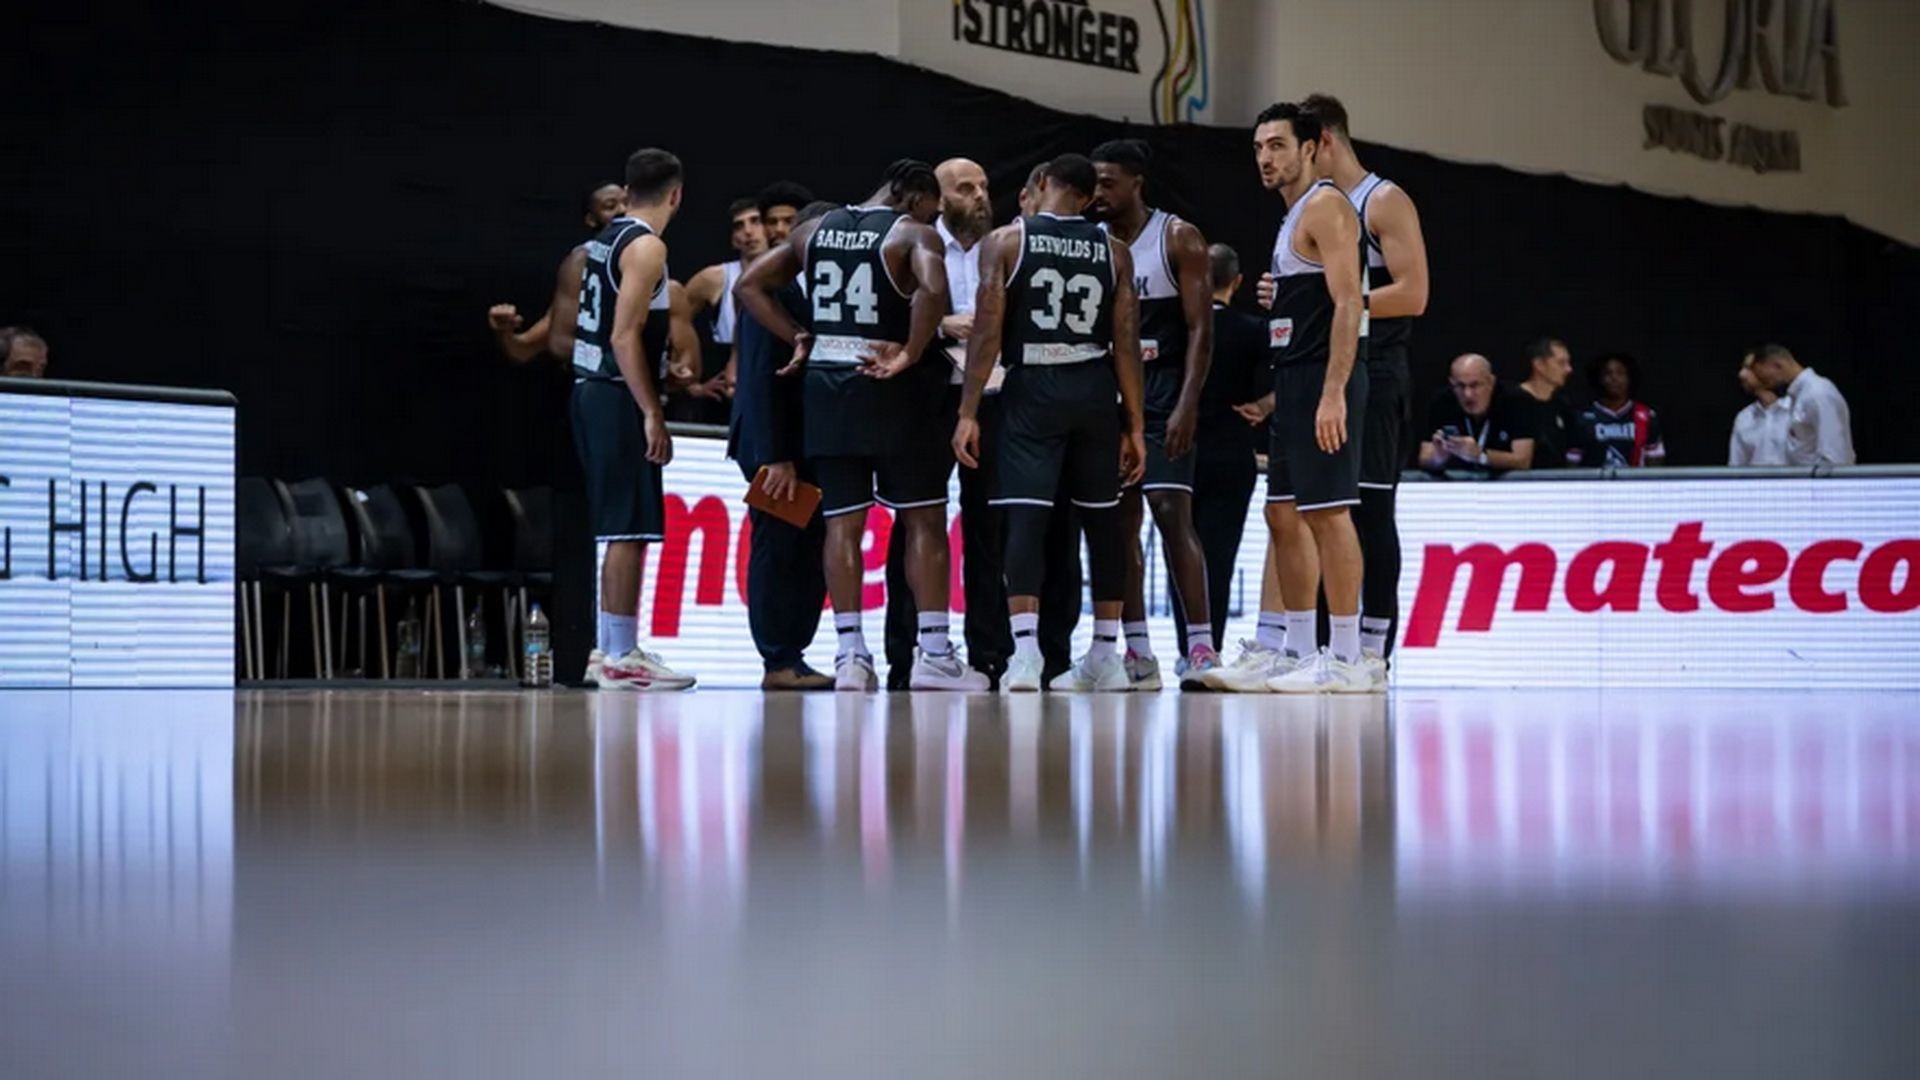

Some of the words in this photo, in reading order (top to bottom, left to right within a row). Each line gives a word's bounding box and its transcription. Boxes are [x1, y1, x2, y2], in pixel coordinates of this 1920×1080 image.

[816, 229, 879, 250] BARTLEY
[1028, 234, 1091, 260] REYNOLDS
[1092, 243, 1107, 264] JR
[812, 260, 879, 324] 24
[1030, 267, 1103, 335] 33
[48, 478, 207, 584] HIGH
[1402, 521, 1920, 648] mateco
